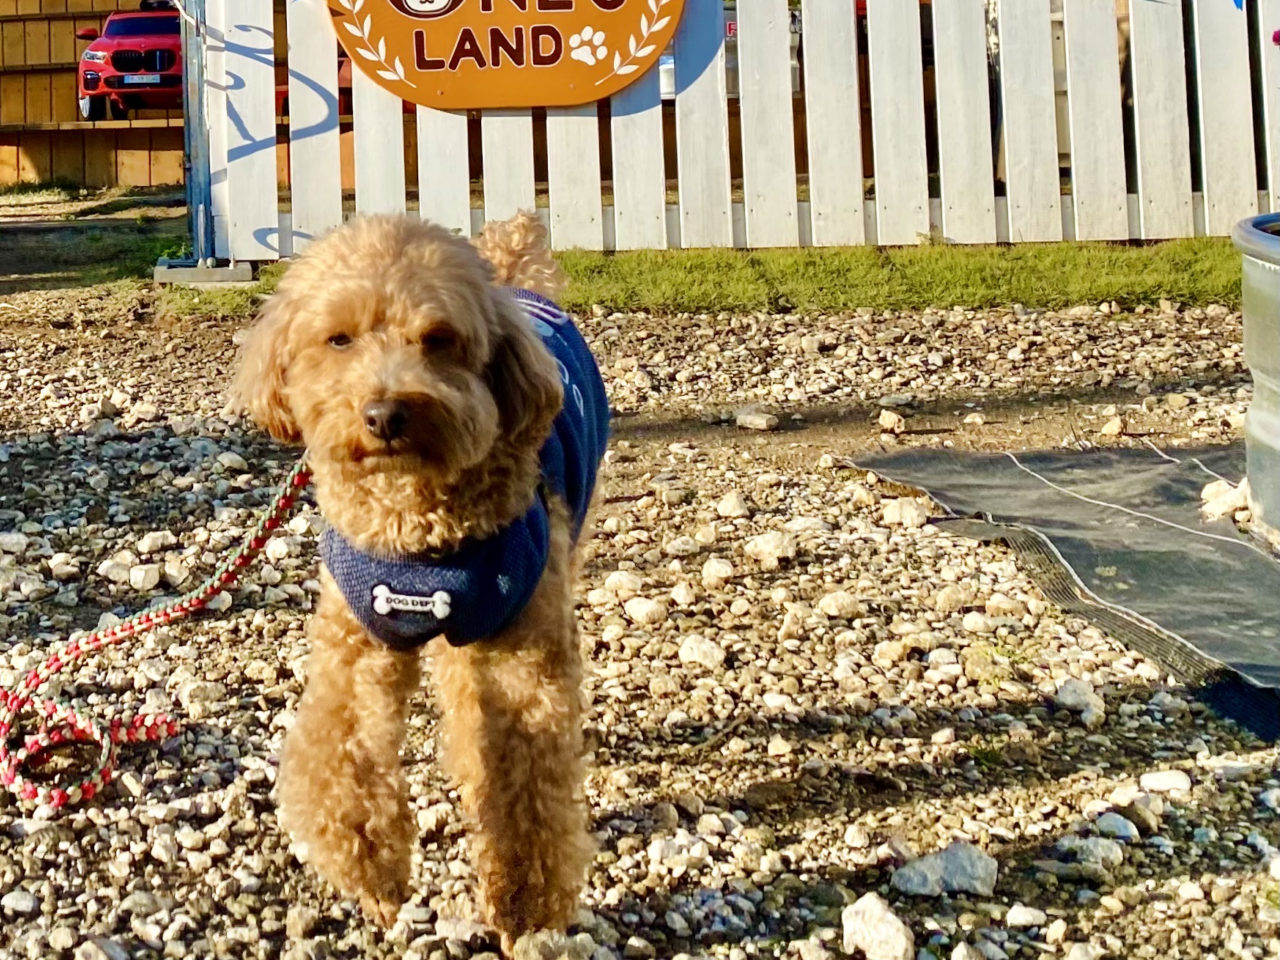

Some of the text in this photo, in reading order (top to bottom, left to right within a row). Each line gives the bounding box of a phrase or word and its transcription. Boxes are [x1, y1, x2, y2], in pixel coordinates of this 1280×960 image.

[413, 24, 563, 72] LAND
[386, 597, 436, 608] DOG DEPT
